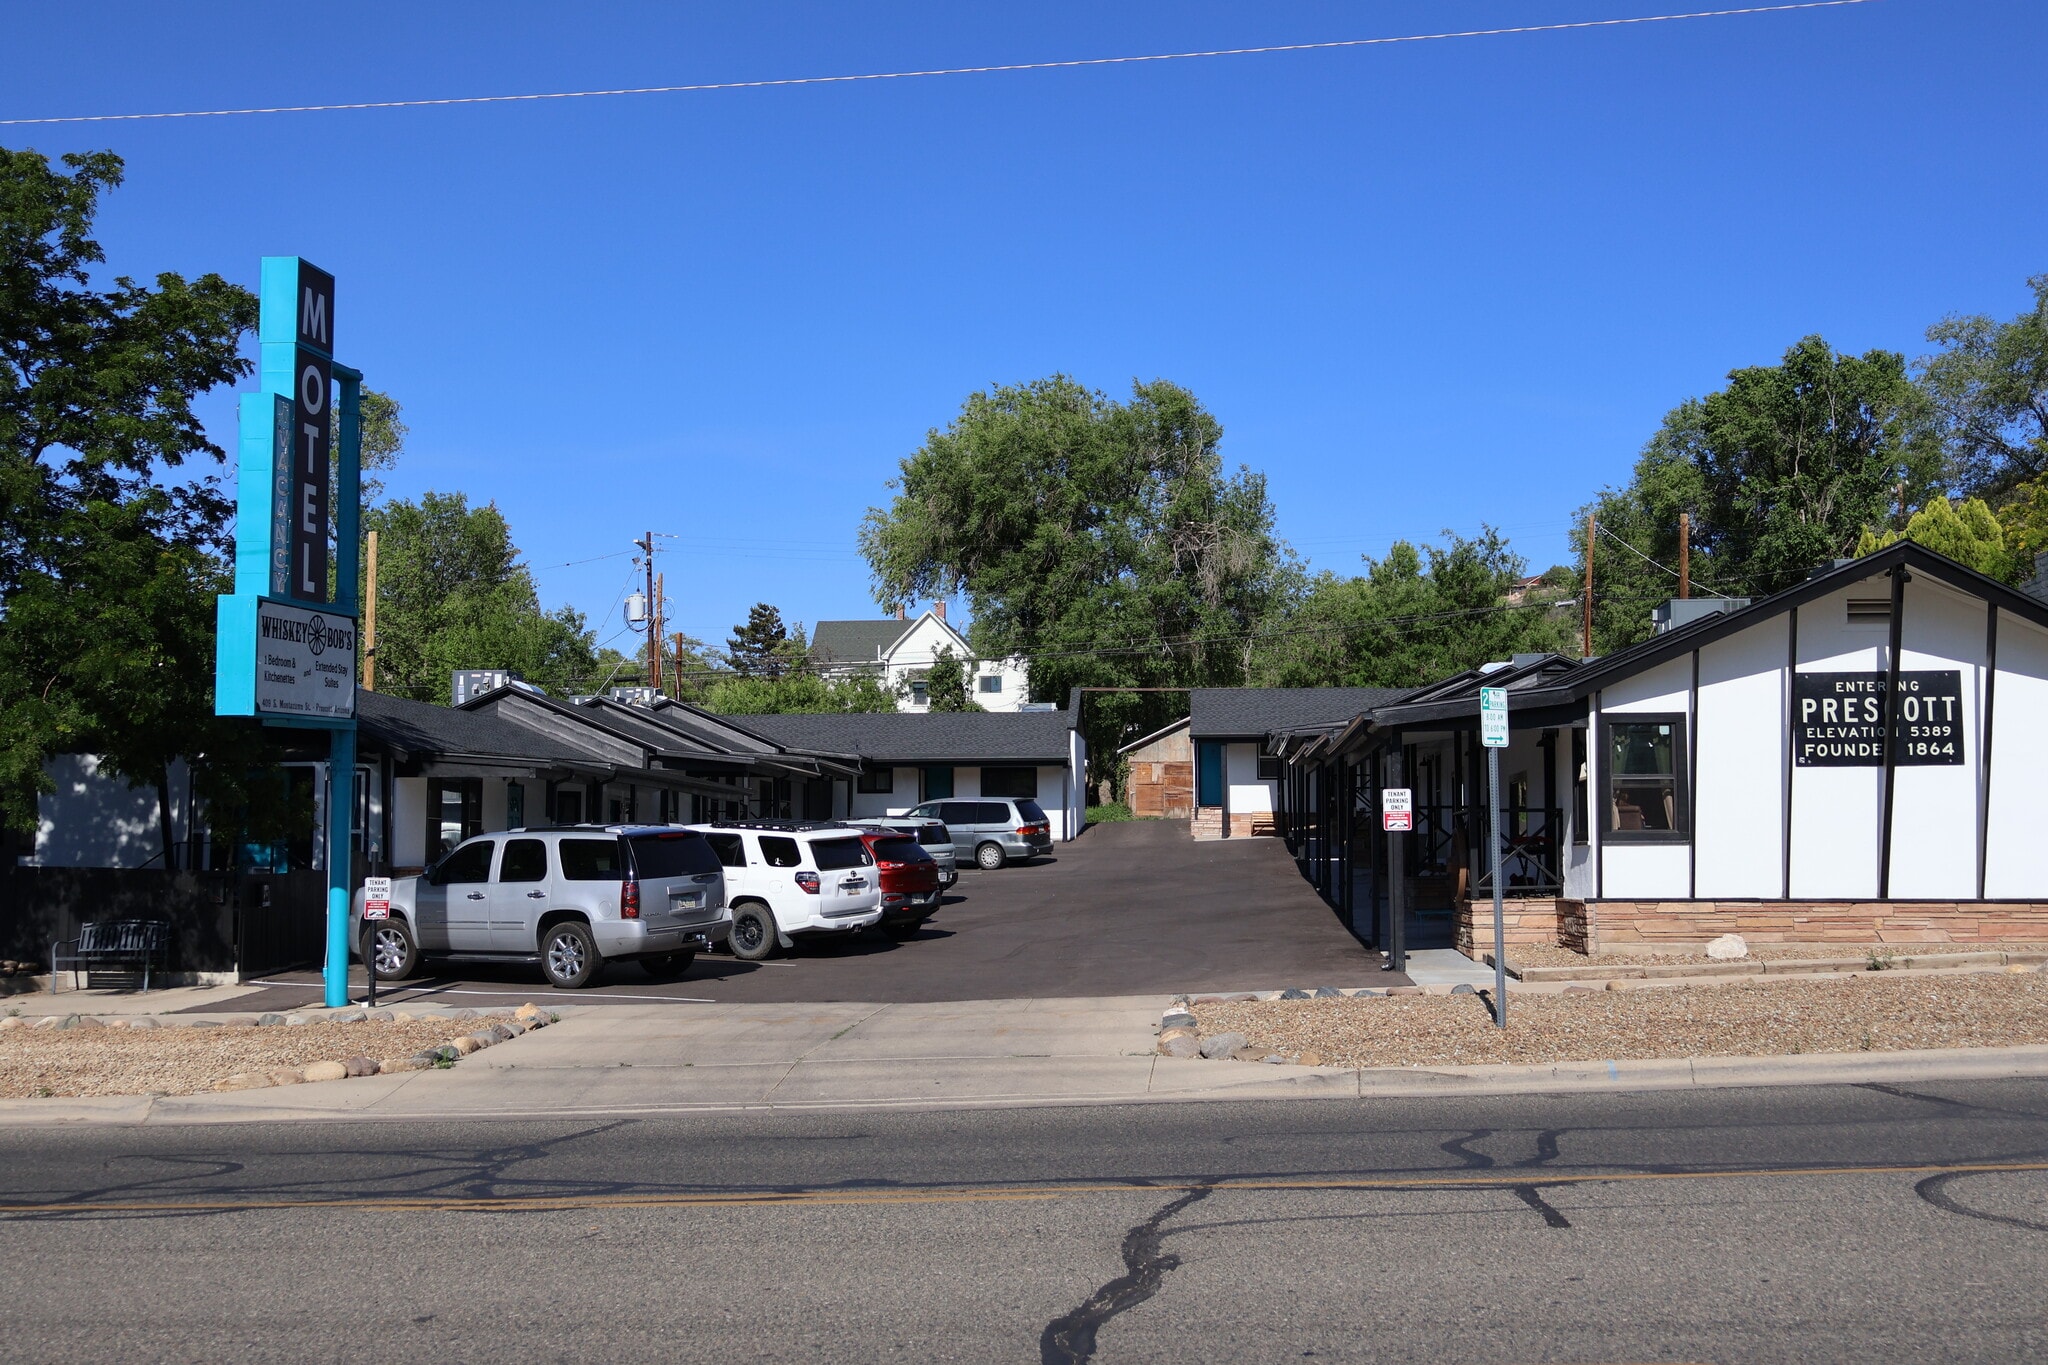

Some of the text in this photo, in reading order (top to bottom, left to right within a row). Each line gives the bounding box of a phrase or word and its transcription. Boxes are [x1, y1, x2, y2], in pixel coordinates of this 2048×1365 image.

[301, 286, 327, 594] MOTEL
[273, 428, 290, 594] VACANCY
[261, 615, 352, 651] WHISKEY BOB'S
[268, 654, 292, 668] Bedroom
[292, 657, 296, 669] &
[316, 660, 349, 677] Extended Stay
[264, 670, 295, 685] Kitchenettes
[325, 676, 339, 688] Suites
[1835, 680, 1920, 693] ENTERNG
[1482, 692, 1489, 707] 2
[1802, 696, 1956, 723] PRESOTT
[1910, 725, 1952, 737] 5389
[1804, 742, 1955, 757] FOUNDE 1864
